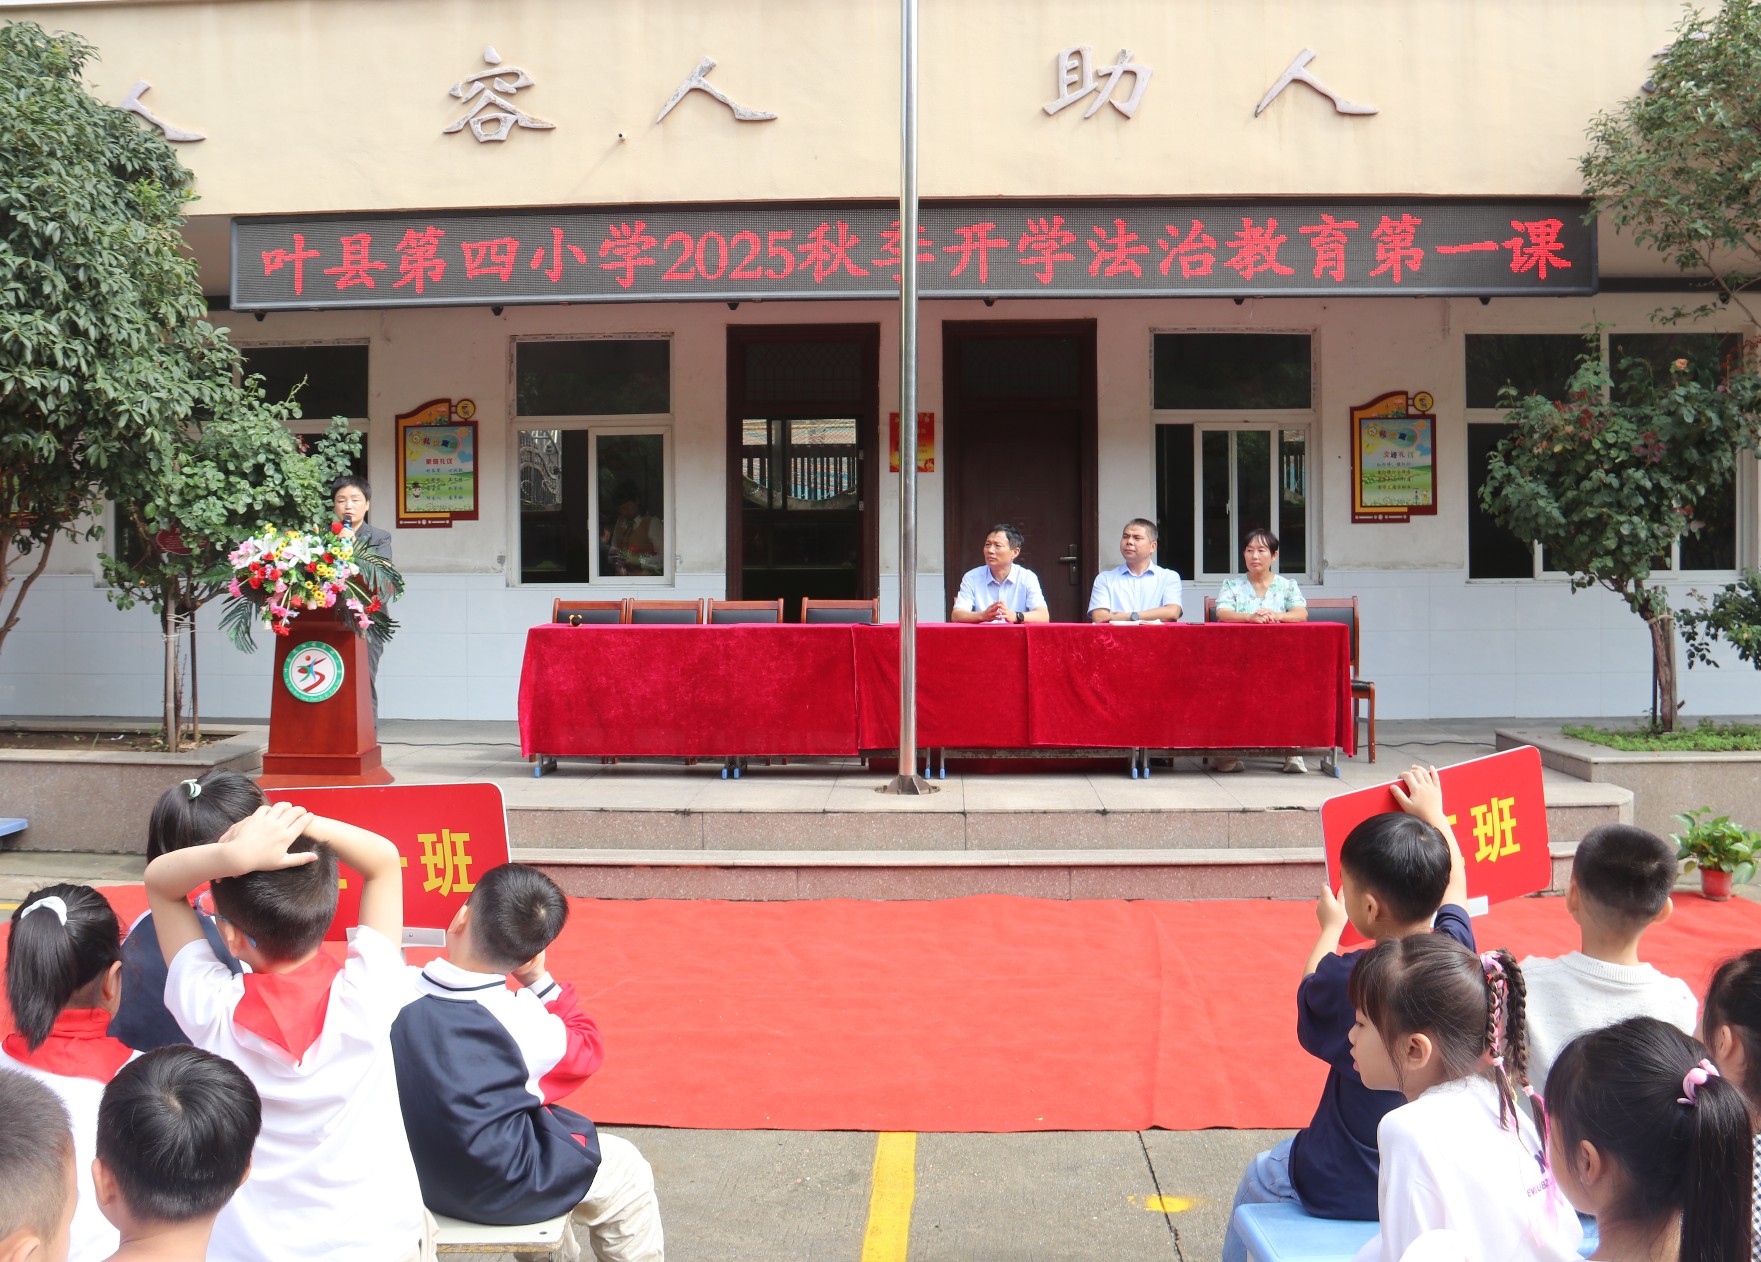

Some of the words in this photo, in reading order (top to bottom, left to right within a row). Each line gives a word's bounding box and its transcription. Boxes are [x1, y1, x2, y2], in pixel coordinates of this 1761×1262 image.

[261, 212, 1571, 296] 叶县第四小学2025秋季开学法治教育第一课
